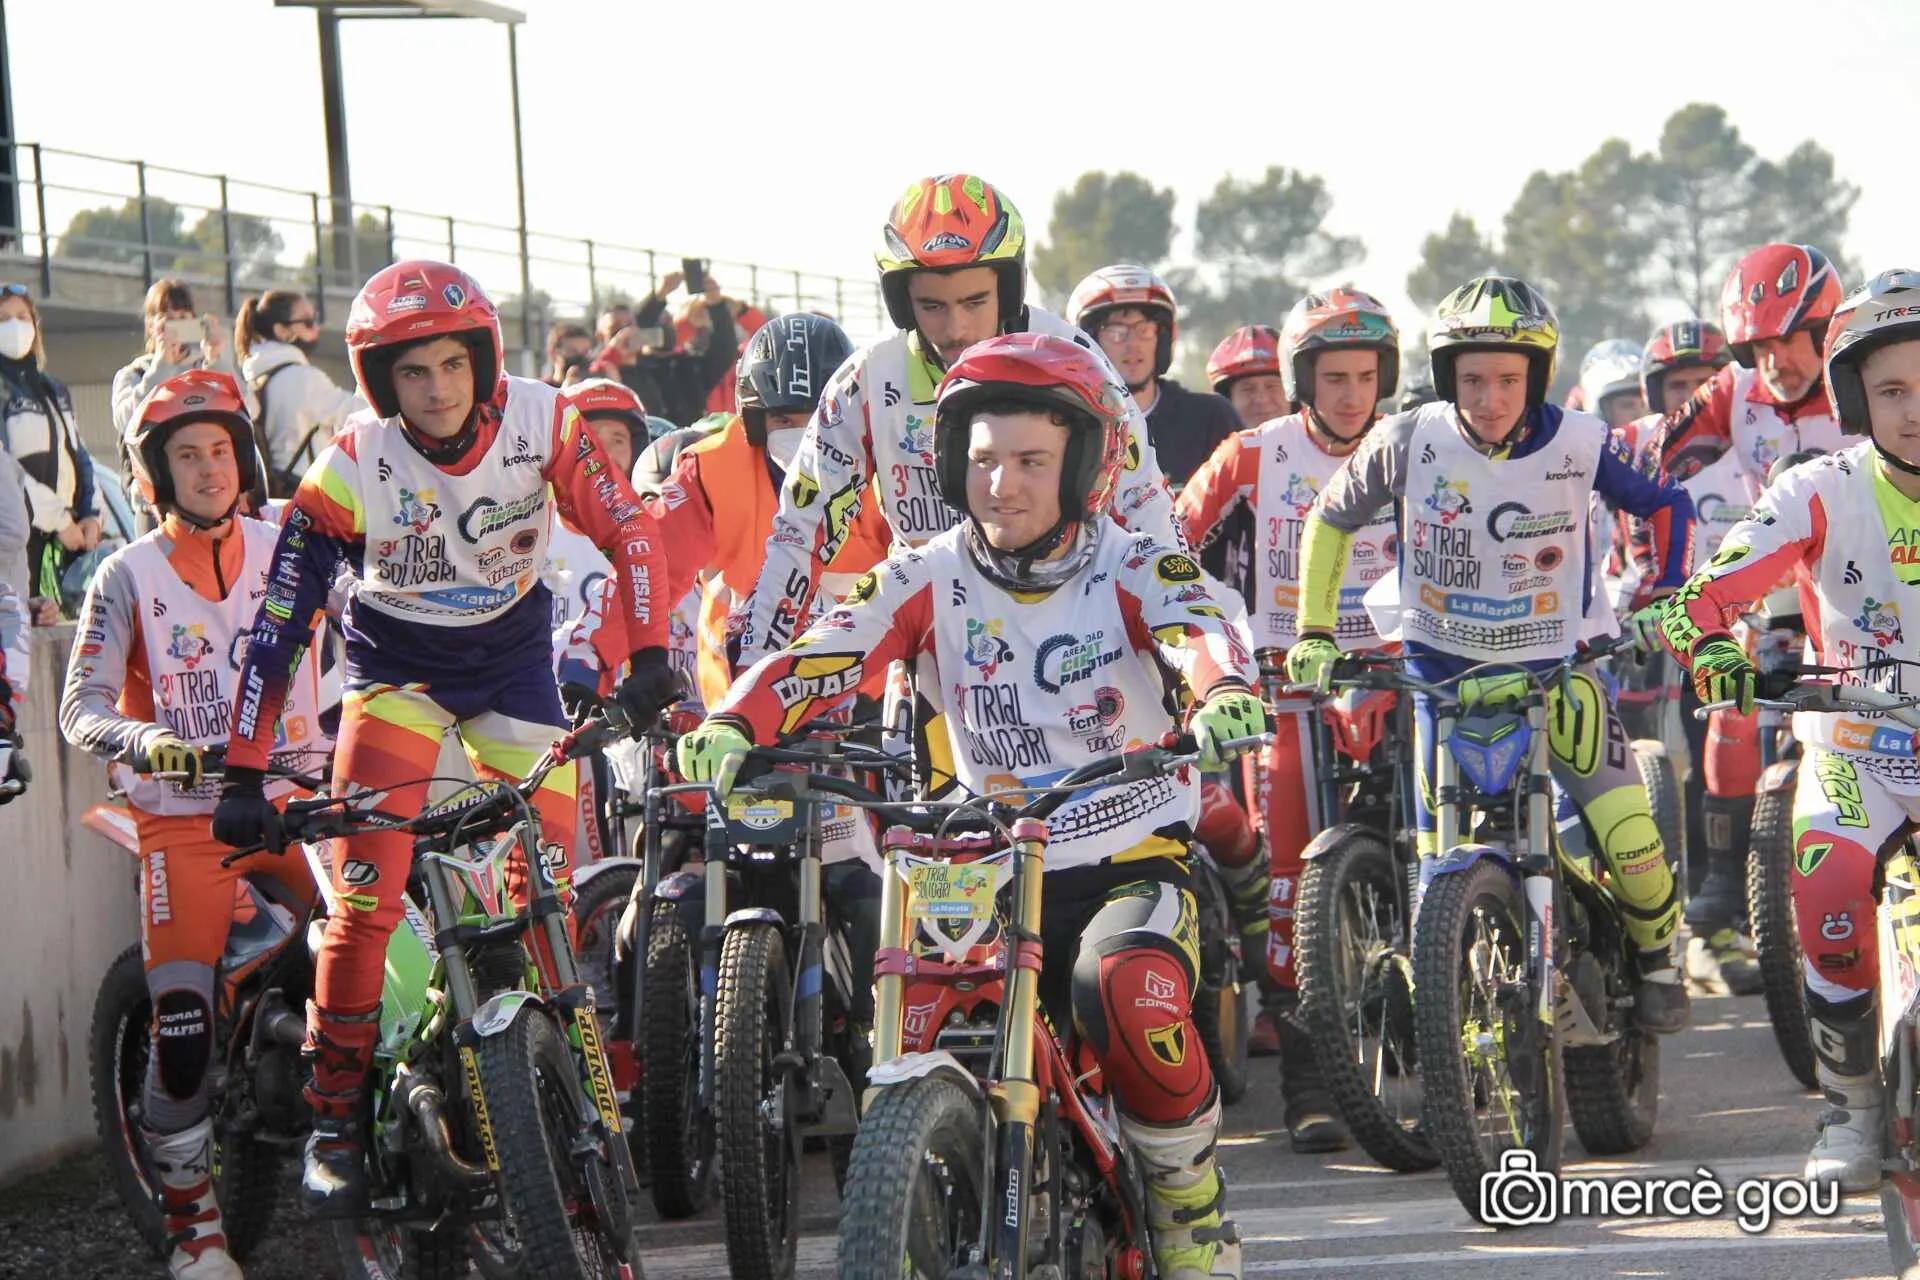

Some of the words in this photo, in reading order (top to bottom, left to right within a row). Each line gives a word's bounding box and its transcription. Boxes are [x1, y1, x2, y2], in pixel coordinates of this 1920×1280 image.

[1878, 734, 1901, 750] La
[149, 850, 172, 926] MOTUL
[578, 1013, 615, 1115] DUNLOP
